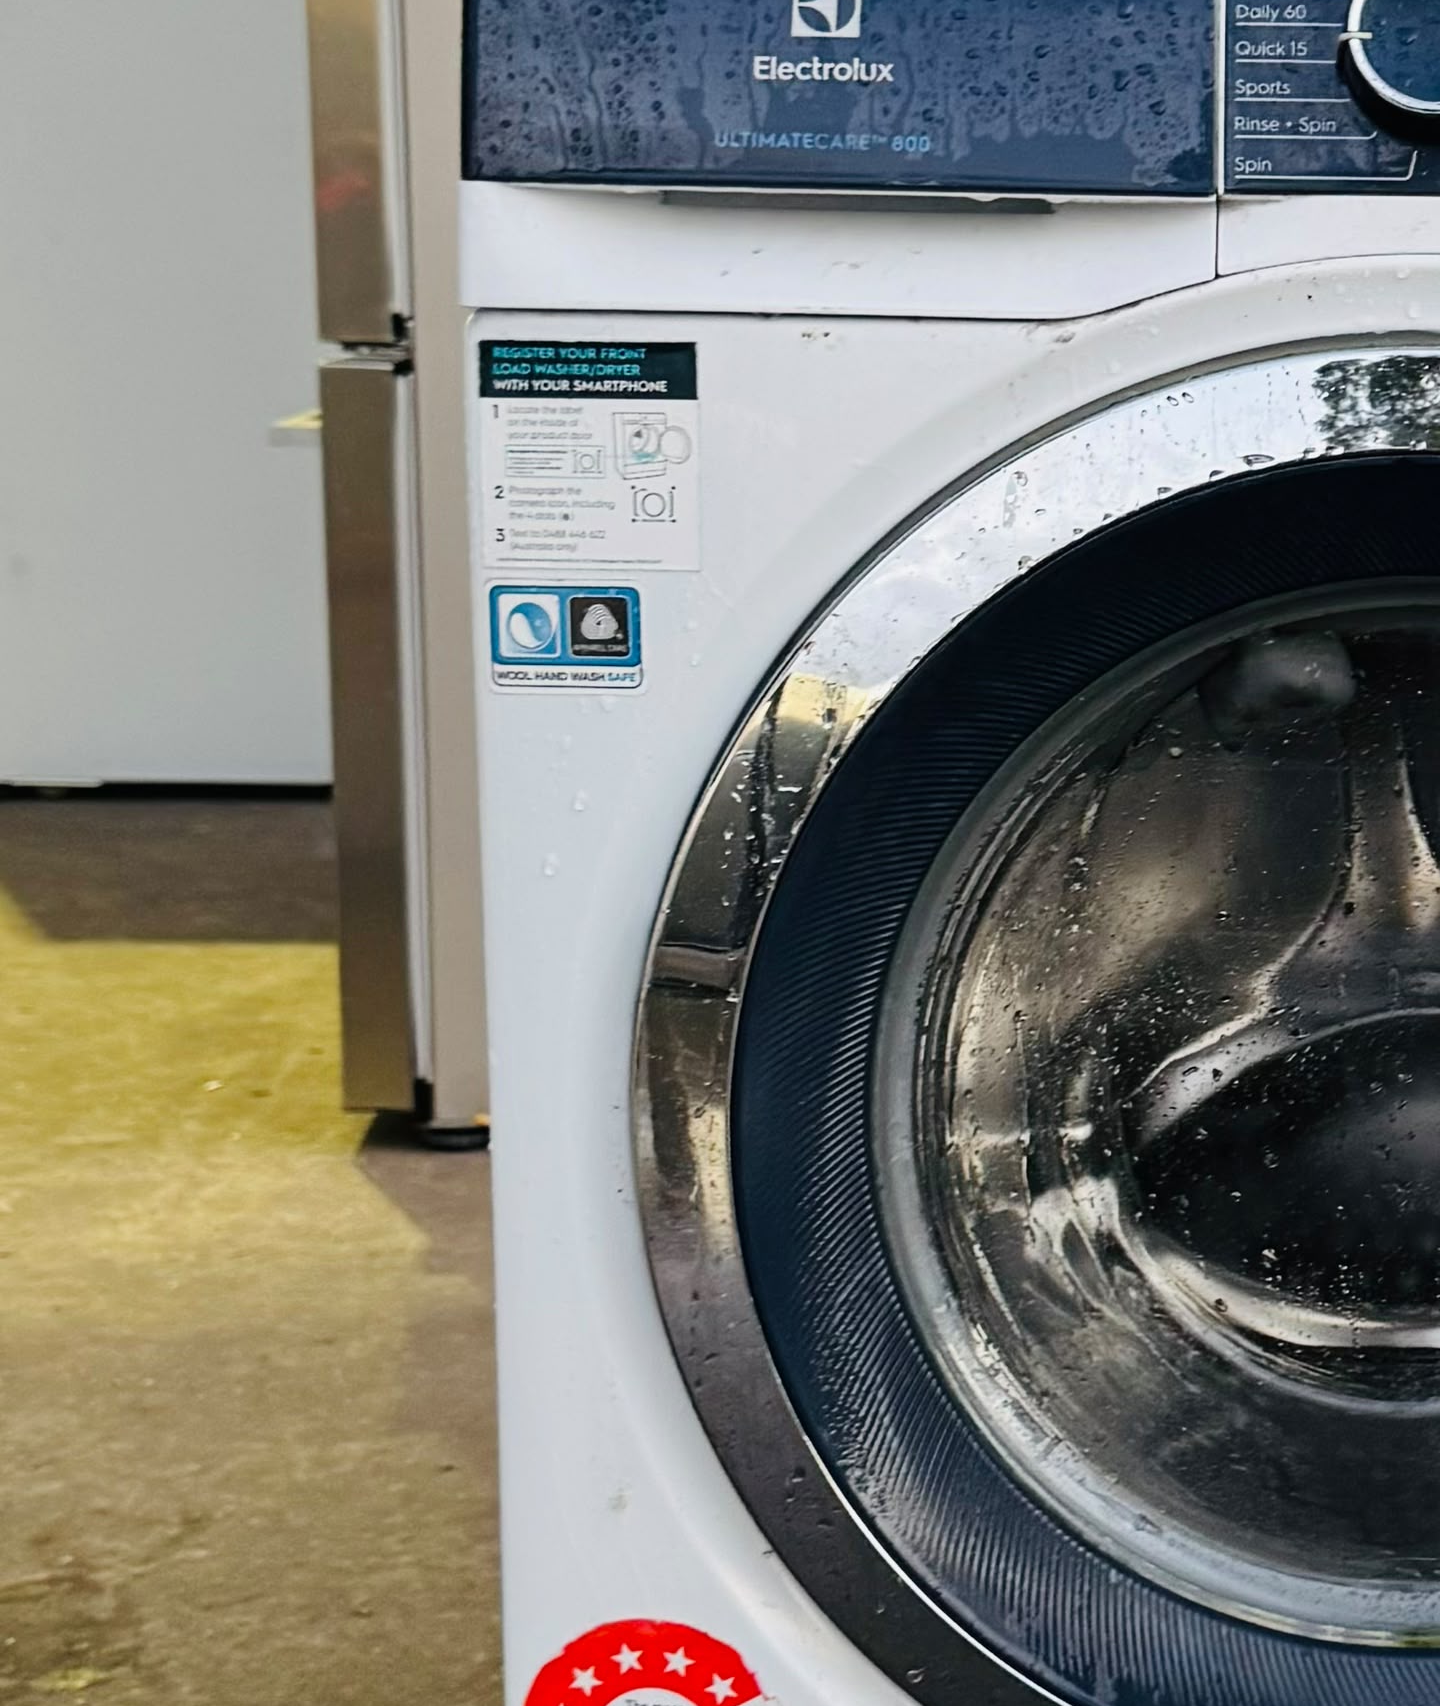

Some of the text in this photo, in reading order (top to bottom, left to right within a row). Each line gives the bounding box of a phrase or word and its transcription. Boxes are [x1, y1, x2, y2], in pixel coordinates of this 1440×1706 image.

[1235, 5, 1307, 22] Daily 60
[1234, 41, 1307, 56] Quick 15
[753, 56, 894, 82] Electrolux
[1234, 79, 1291, 96] Sports
[1234, 116, 1280, 131] Rinse
[1299, 118, 1336, 133] Spin
[891, 135, 931, 152] 800
[1234, 157, 1272, 174] Spin
[492, 347, 647, 360] REGISTER YOUR FRONT
[492, 363, 641, 376] LOAD WASHER/DRYER
[493, 379, 668, 393] WITH YOUR SMARTPHONE
[493, 404, 499, 419] 1
[494, 485, 505, 499] 2
[495, 528, 505, 542] 3
[496, 671, 636, 682] WOOL HAND WASH SAFE
